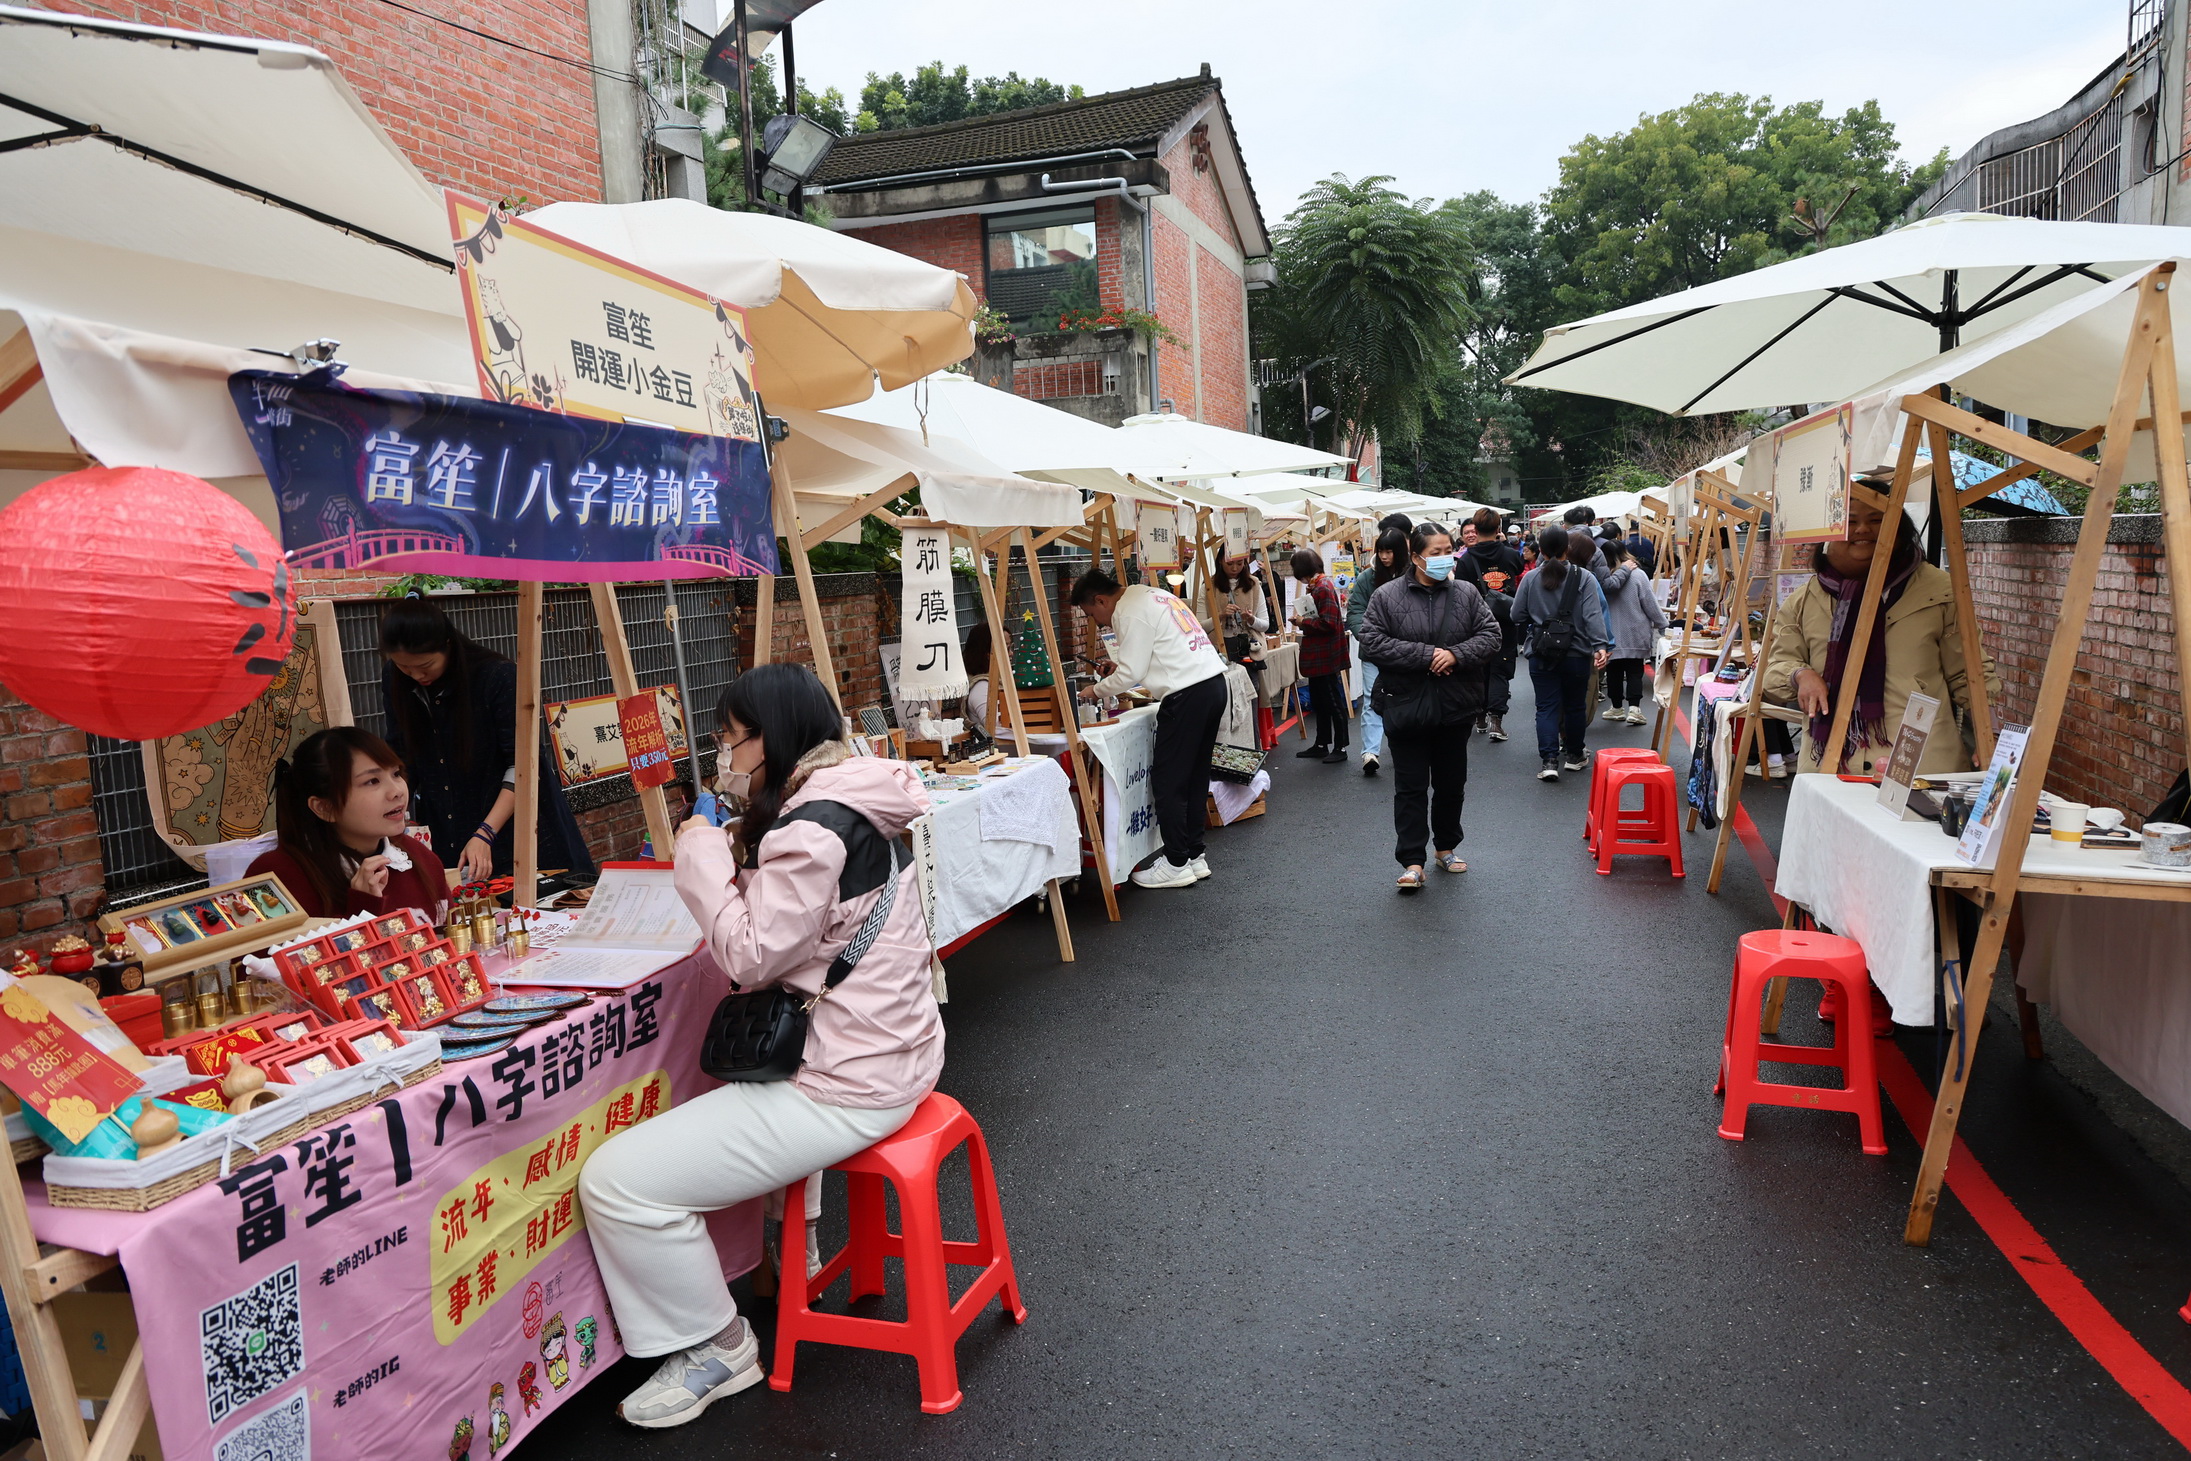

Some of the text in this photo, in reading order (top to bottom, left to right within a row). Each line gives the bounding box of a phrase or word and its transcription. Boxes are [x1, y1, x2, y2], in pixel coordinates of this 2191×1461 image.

[602, 301, 656, 351] 富笙
[570, 339, 698, 409] 開運小金豆
[915, 536, 950, 672] 筋膜刀
[624, 711, 658, 734] 2026年
[626, 729, 665, 756] 流年解析
[27, 1043, 72, 1079] 888元
[319, 1225, 408, 1287] 老師的LINE
[333, 1355, 400, 1409] 老師的IG
